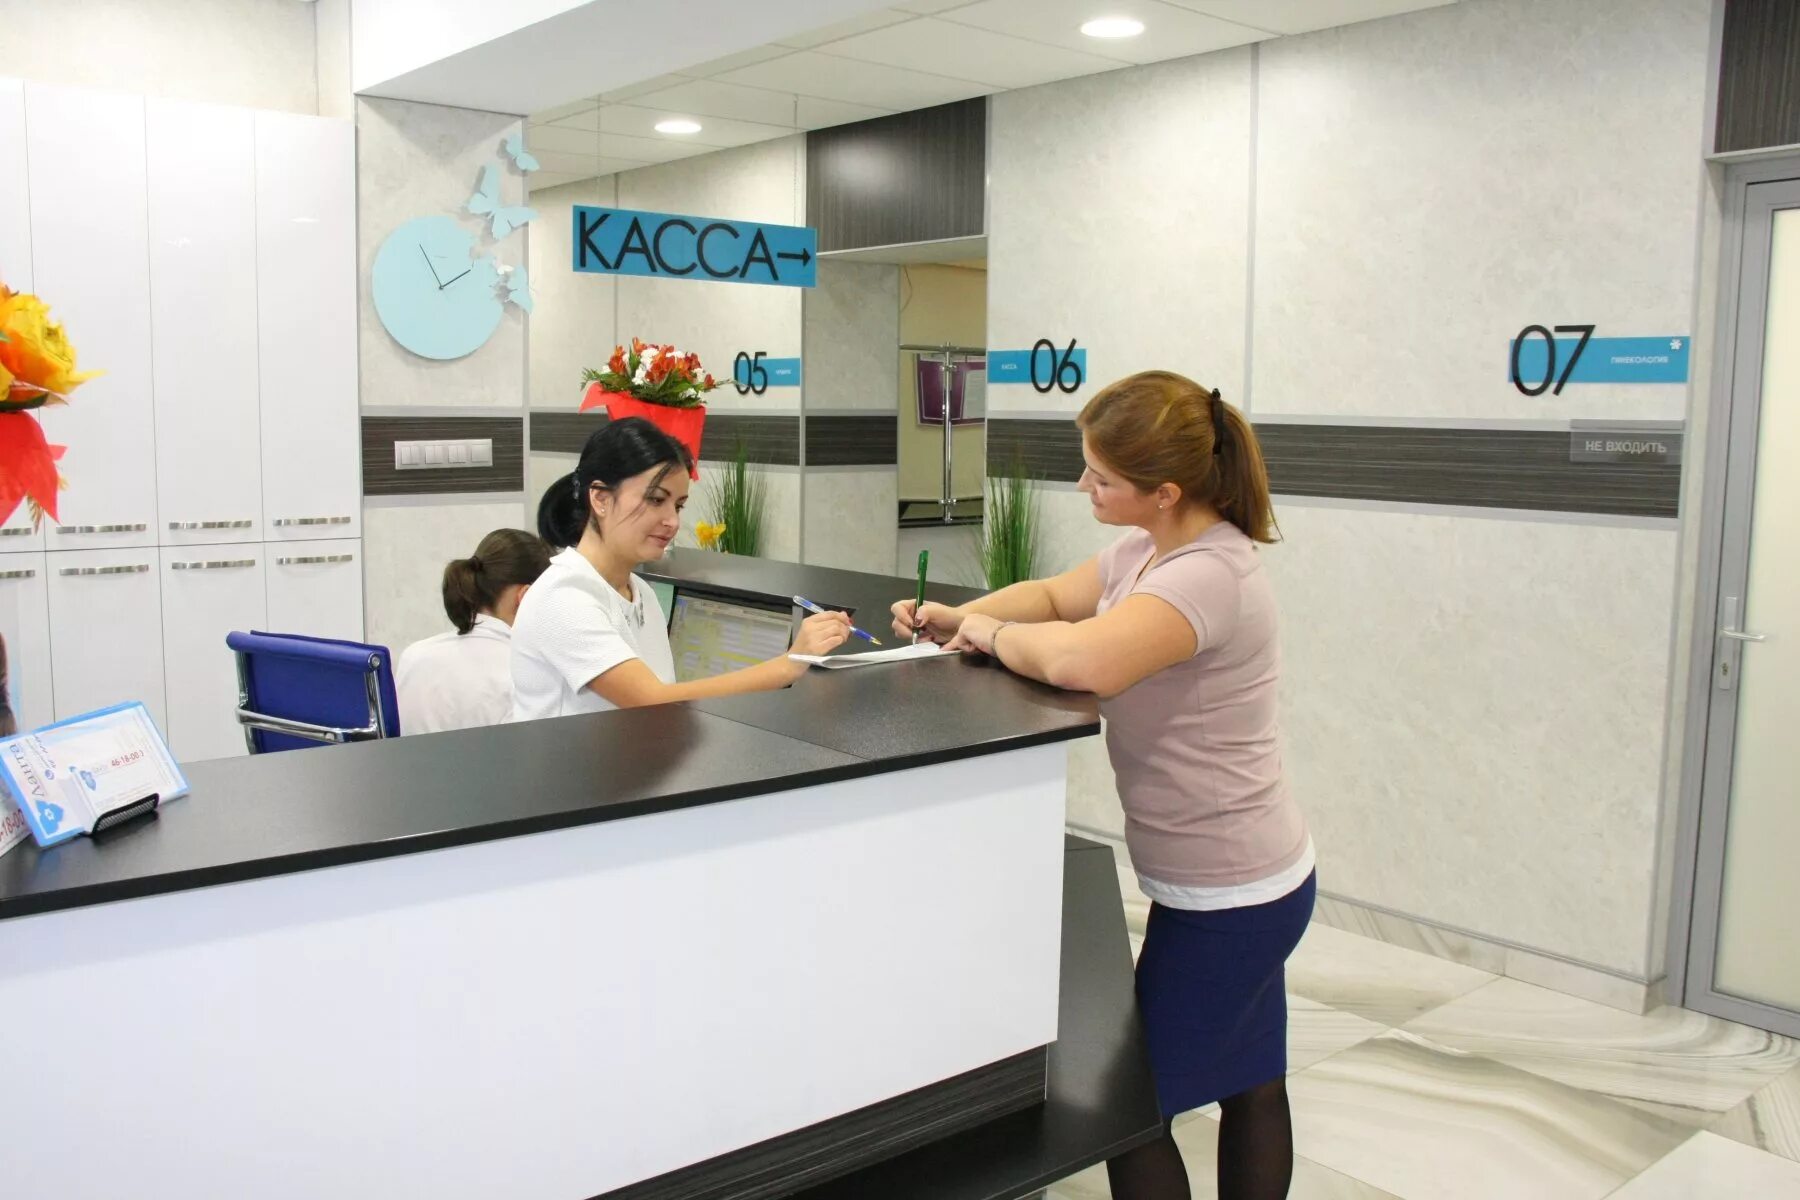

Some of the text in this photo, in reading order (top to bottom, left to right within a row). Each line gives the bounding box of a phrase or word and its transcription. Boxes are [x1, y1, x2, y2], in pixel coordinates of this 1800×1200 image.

[580, 211, 779, 281] КАССА
[734, 351, 768, 395] 05
[1030, 338, 1082, 394] 06
[1512, 324, 1596, 396] 07
[1585, 440, 1668, 455] НЕ ВХОДИТЬ
